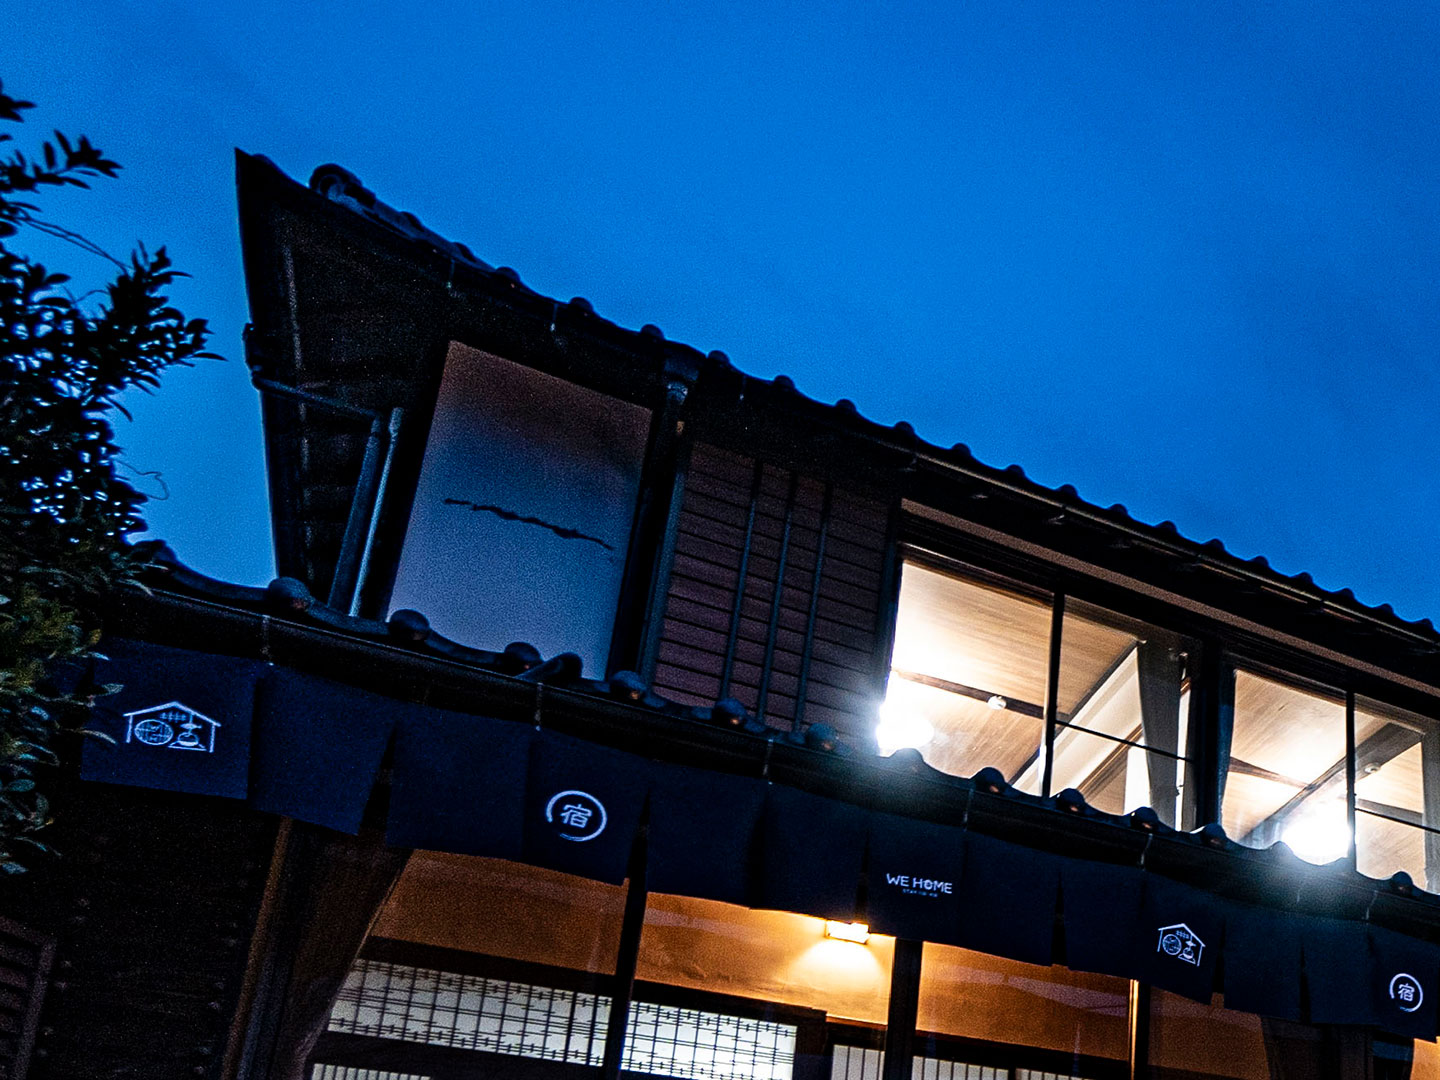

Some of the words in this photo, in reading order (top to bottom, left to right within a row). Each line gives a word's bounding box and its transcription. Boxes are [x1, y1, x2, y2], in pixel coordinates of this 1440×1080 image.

[560, 804, 593, 828] 宿
[886, 872, 910, 887] WE
[912, 877, 953, 894] HOME
[1397, 982, 1415, 1002] 宿
